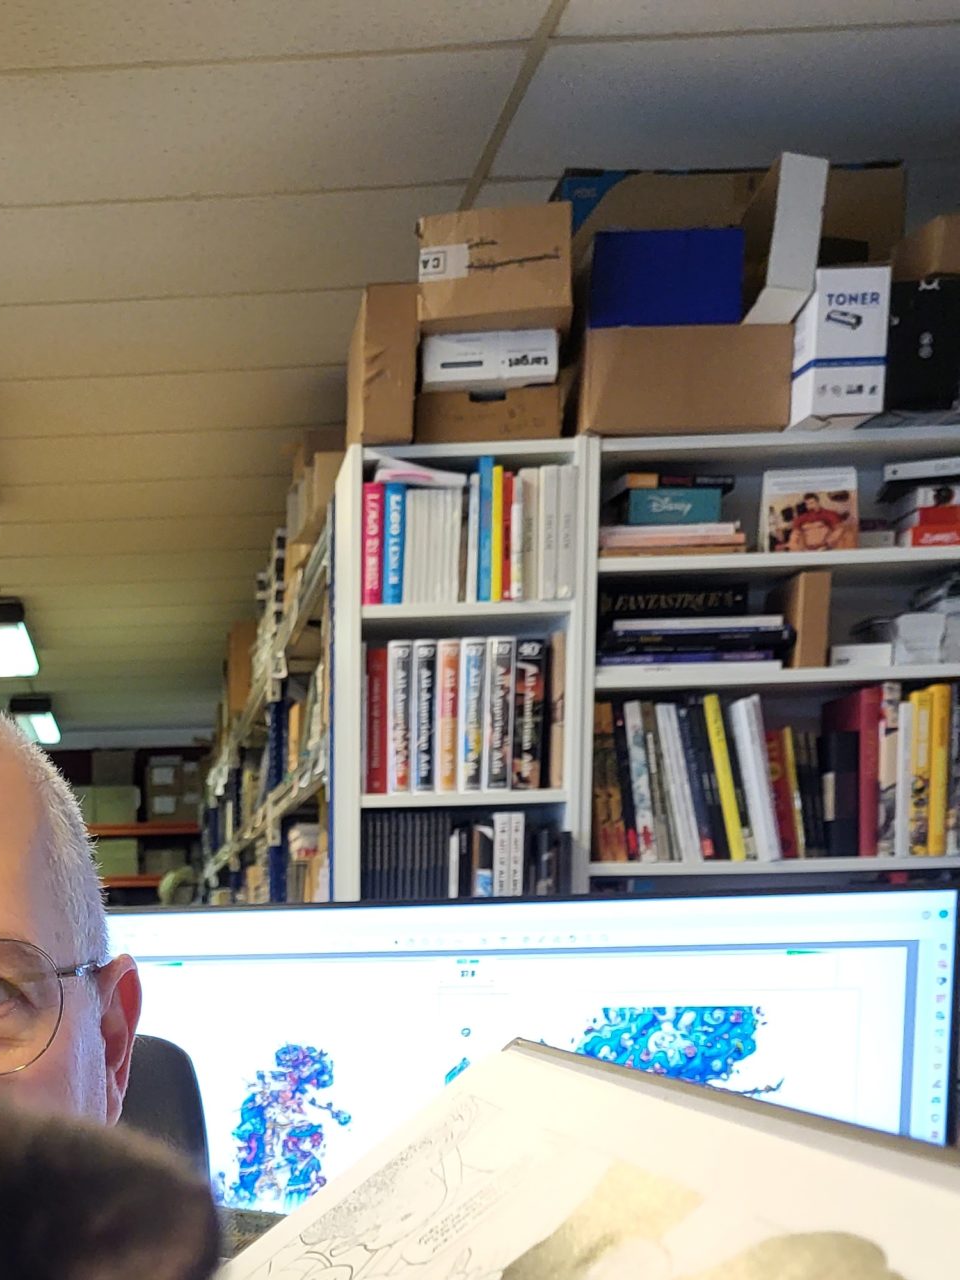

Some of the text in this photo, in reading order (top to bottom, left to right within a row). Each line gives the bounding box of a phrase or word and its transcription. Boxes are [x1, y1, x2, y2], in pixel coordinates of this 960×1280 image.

[826, 291, 880, 306] TONER
[508, 354, 548, 368] target
[648, 495, 692, 516] Disney
